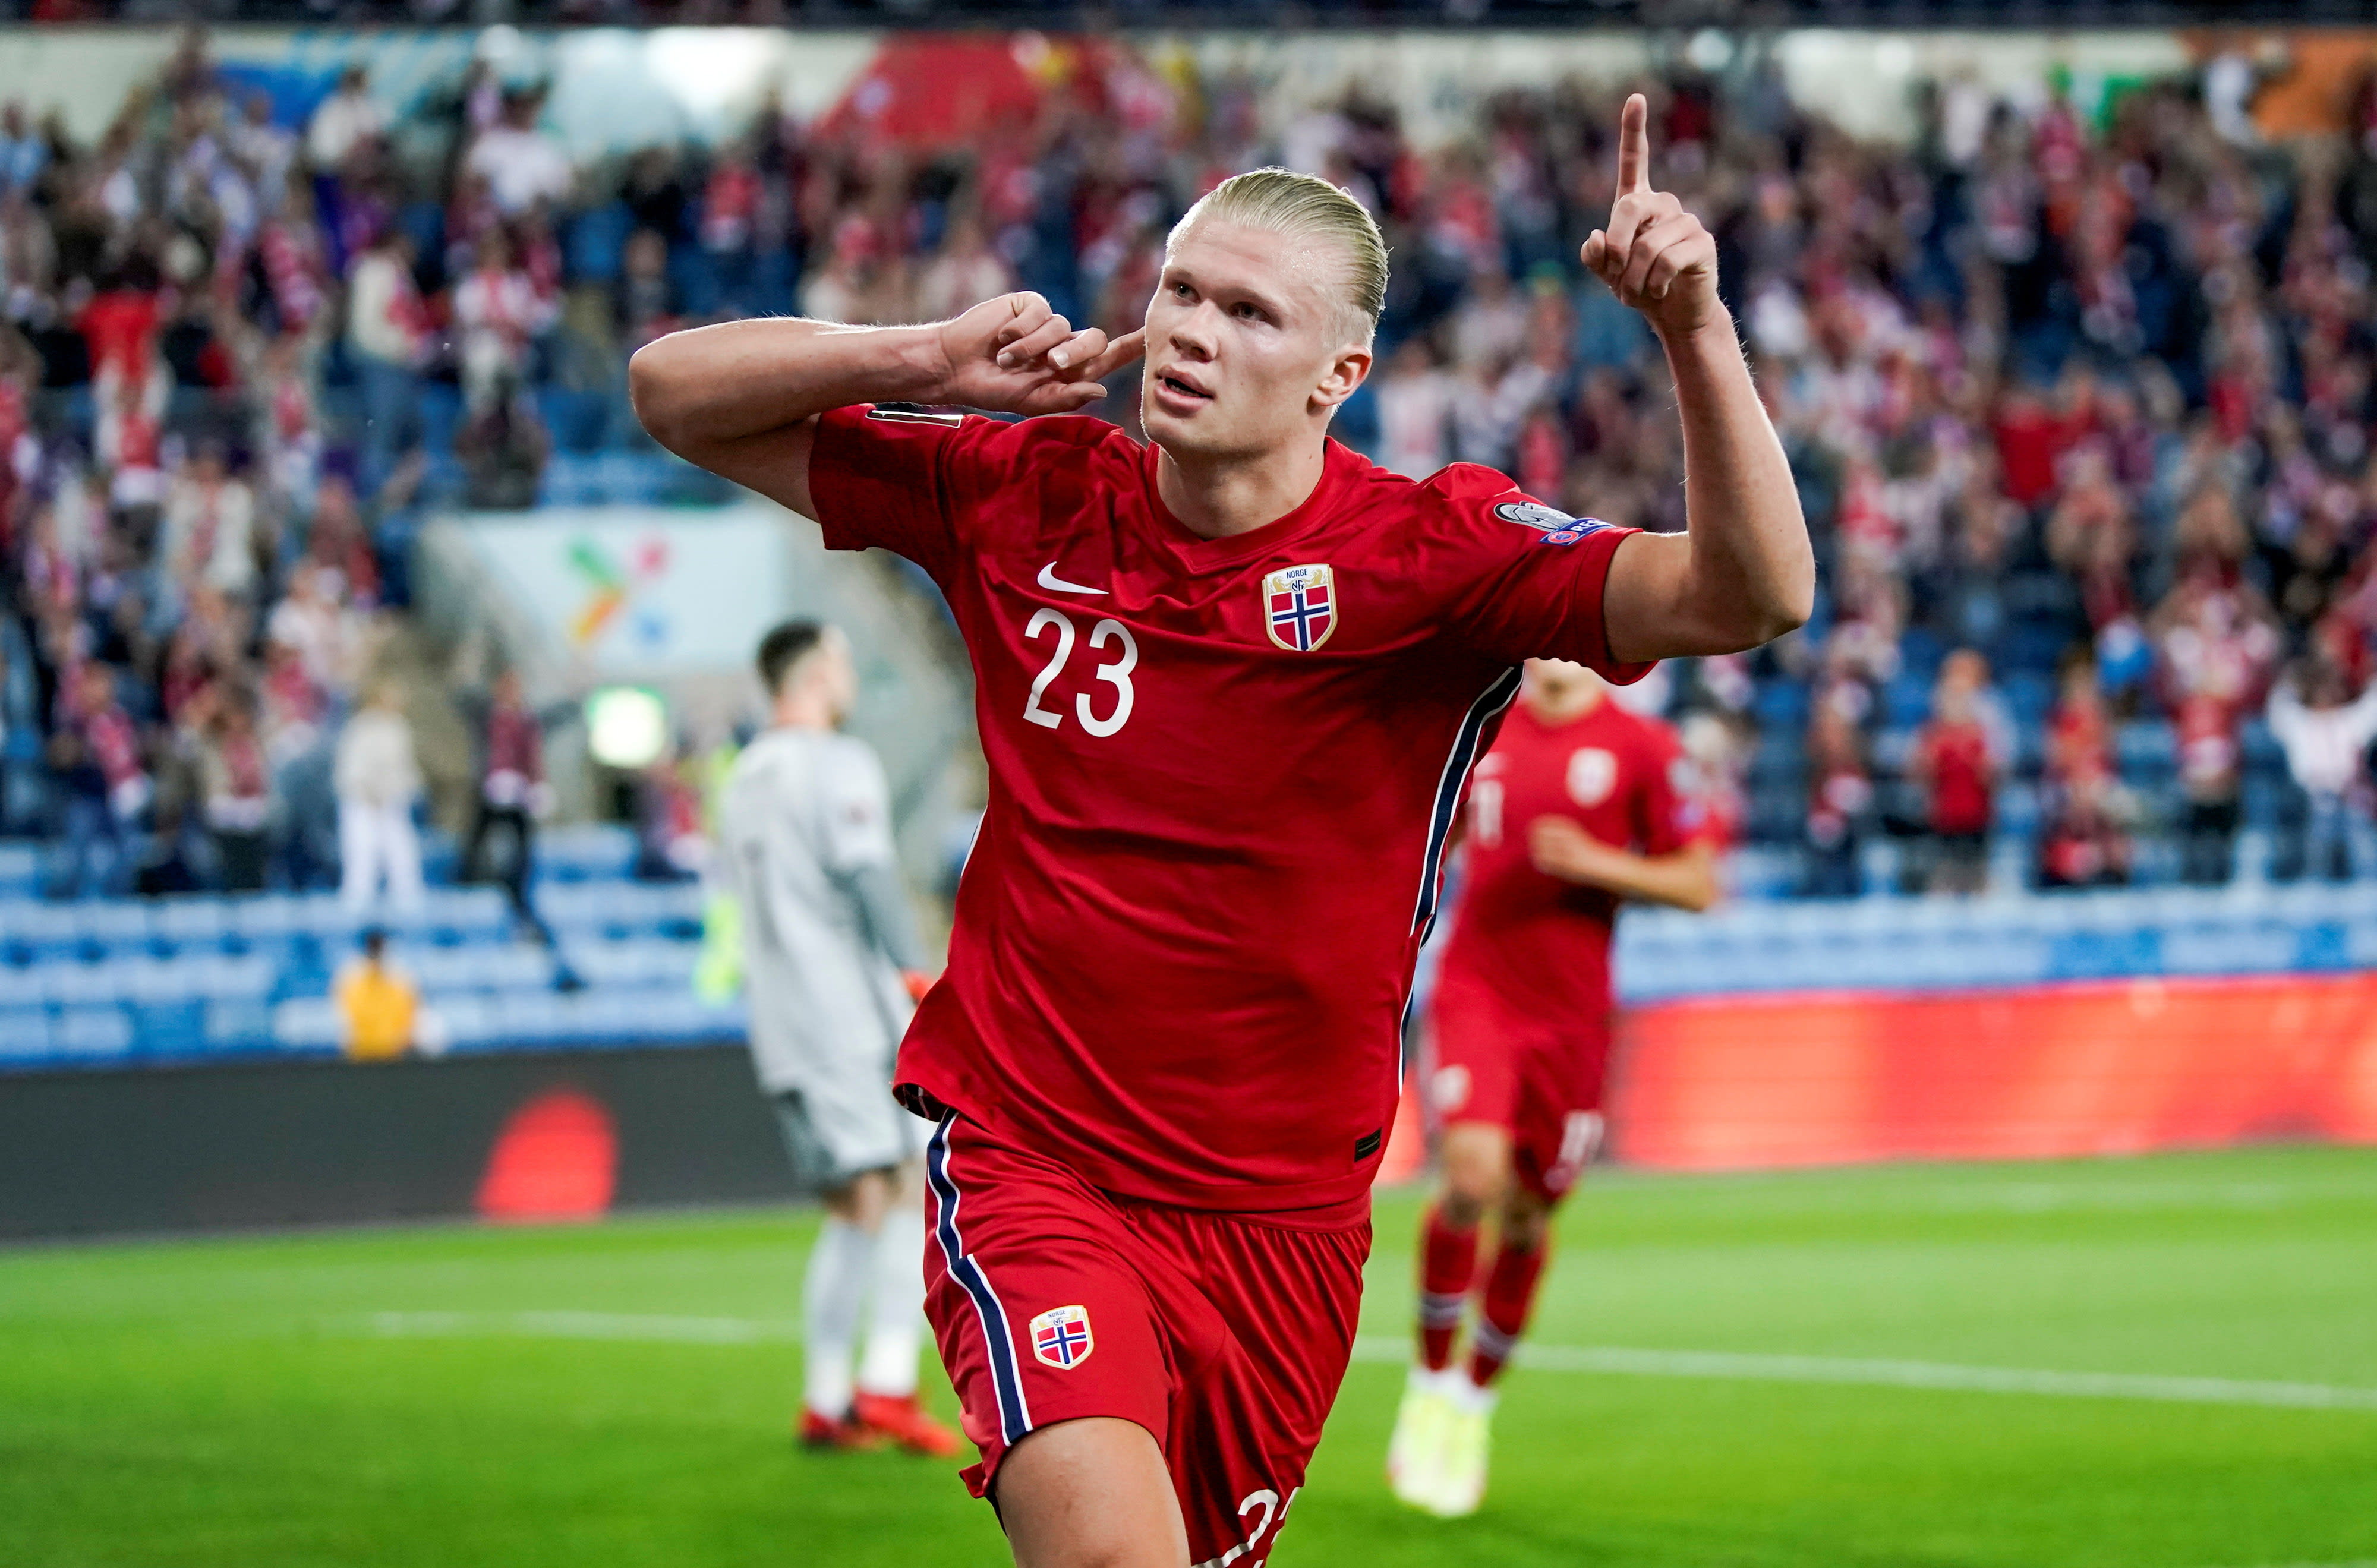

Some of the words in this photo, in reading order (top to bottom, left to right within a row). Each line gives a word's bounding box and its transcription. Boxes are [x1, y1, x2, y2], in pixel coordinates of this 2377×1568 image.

[1286, 568, 1308, 579] NORGE
[1023, 607, 1139, 737] 23
[1048, 1309, 1065, 1318] NORGE
